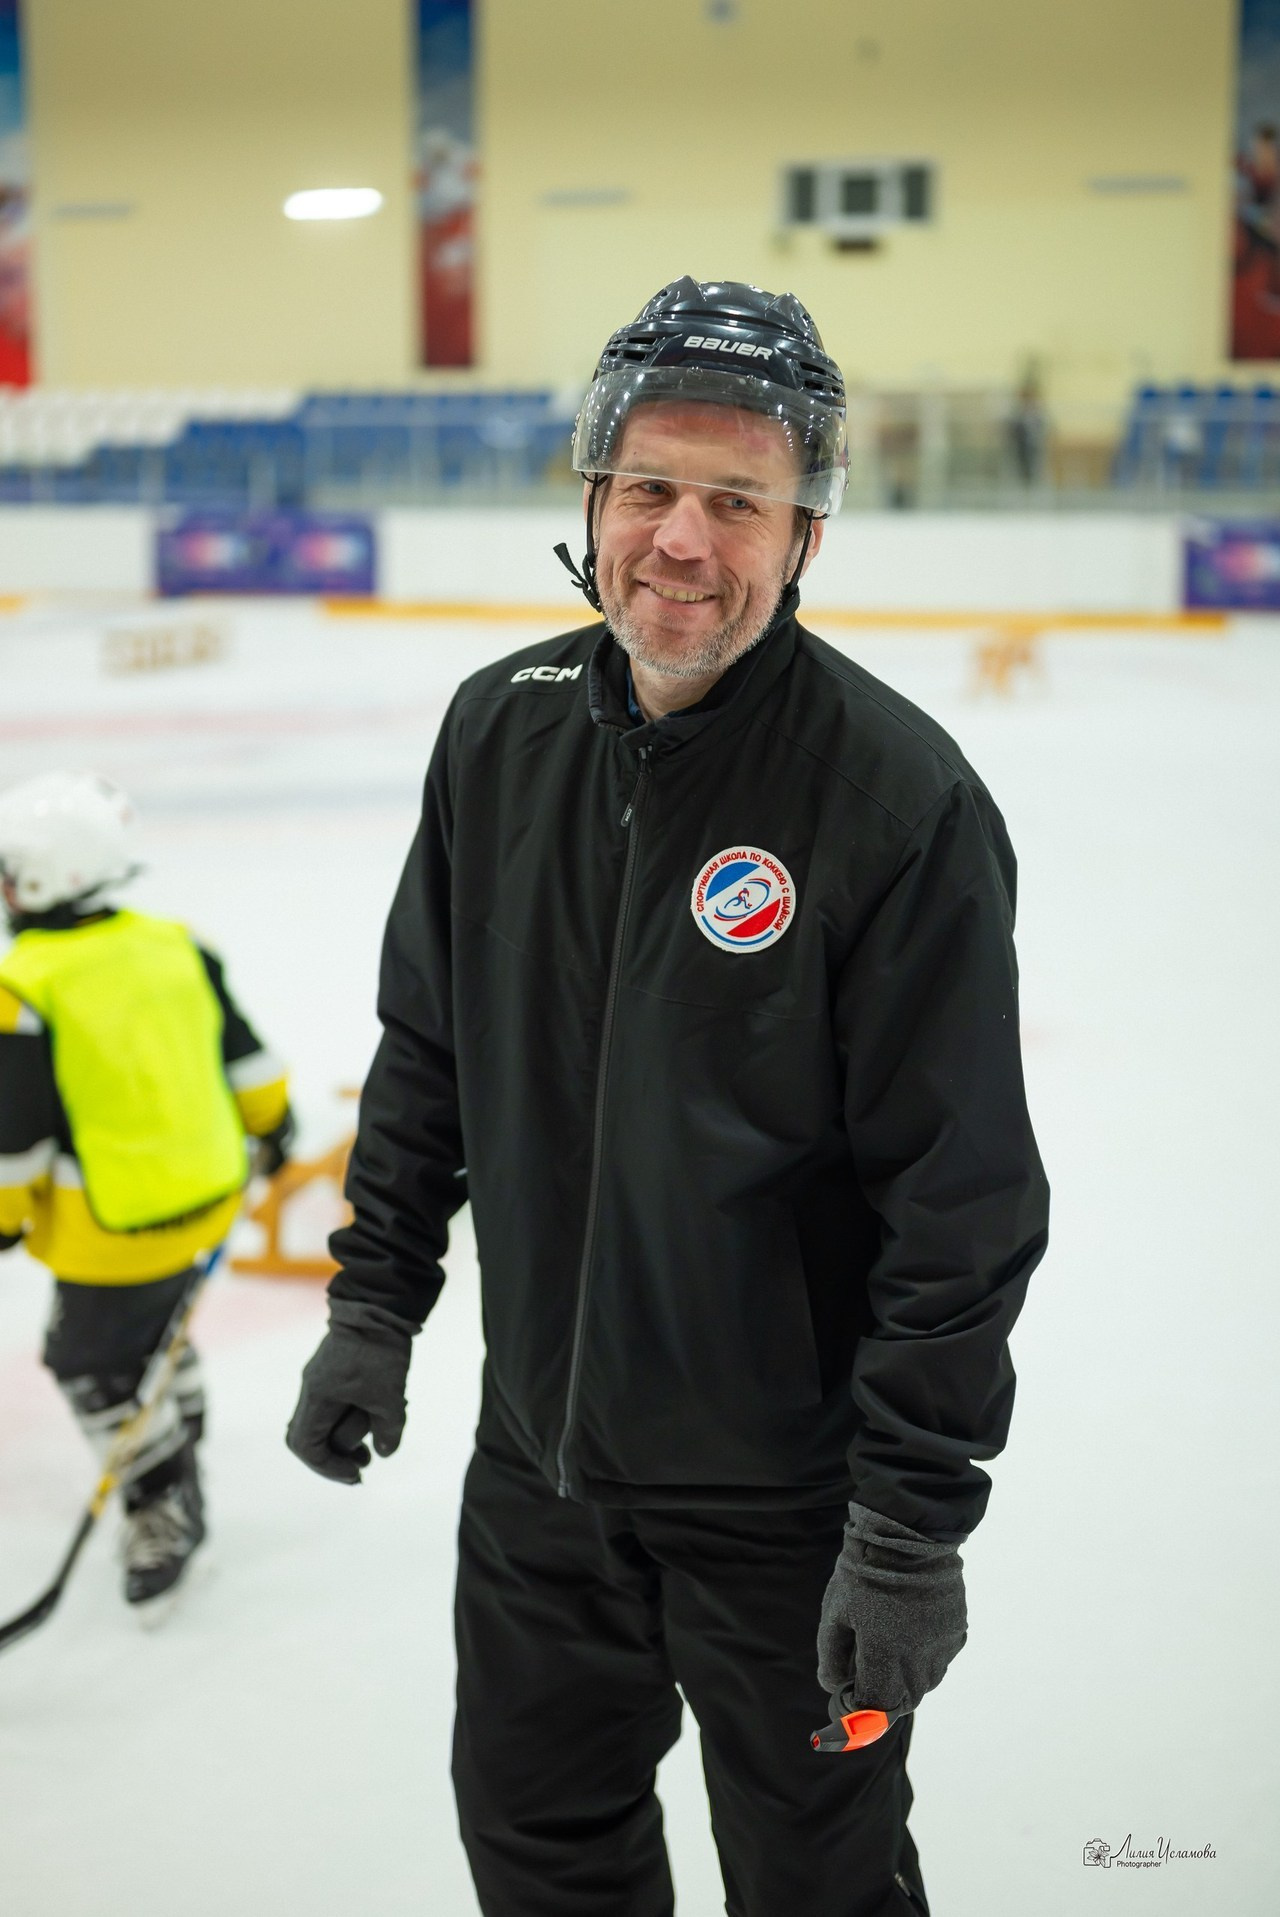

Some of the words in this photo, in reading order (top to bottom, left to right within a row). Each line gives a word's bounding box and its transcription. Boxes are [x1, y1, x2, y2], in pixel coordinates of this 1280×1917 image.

[683, 336, 773, 360] BAUER
[510, 663, 583, 683] CCM
[719, 851, 748, 865] ШКОЛА
[749, 852, 762, 862] ПО
[762, 858, 787, 885] ХОККЕЮ
[696, 862, 720, 912] СПОРТИВНАЯ
[773, 896, 791, 931] ШАЙБОЙ
